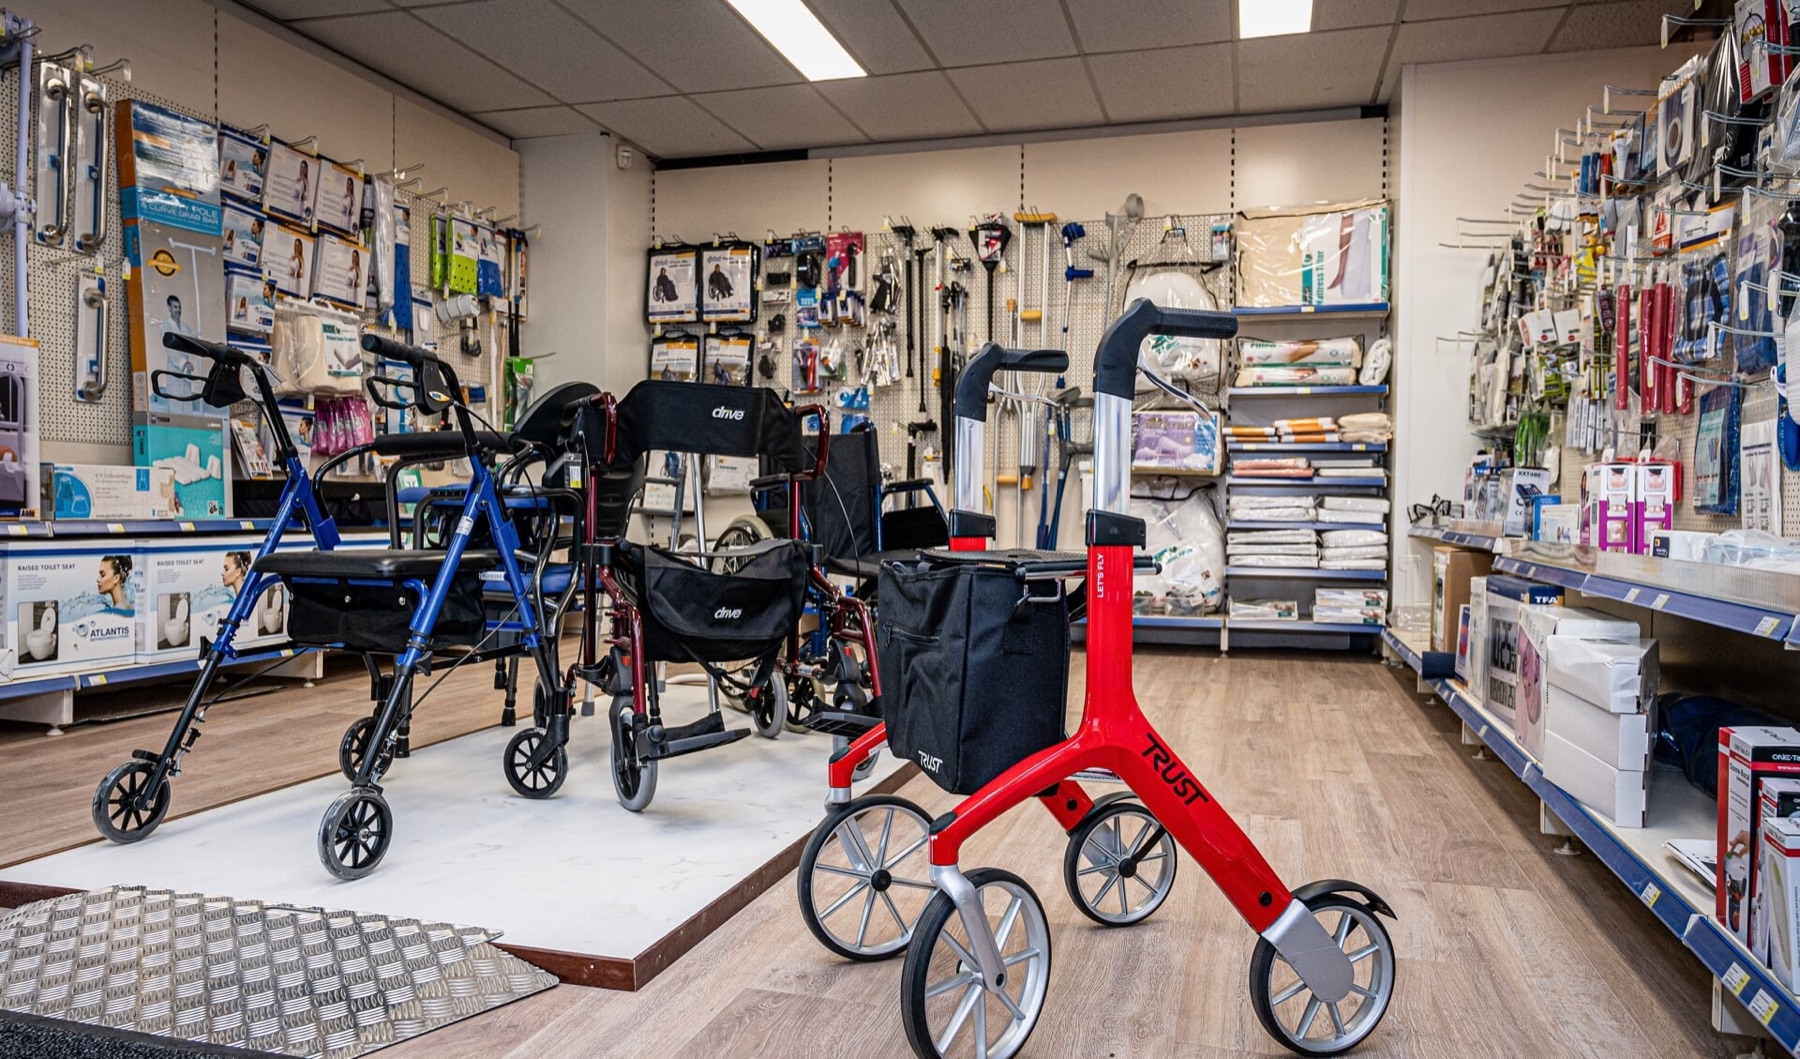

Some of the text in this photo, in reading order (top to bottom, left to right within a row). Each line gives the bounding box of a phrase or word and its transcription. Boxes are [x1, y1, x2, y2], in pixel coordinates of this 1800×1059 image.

[149, 204, 177, 216] CURVE
[178, 210, 201, 221] GRAB
[203, 216, 219, 225] BAR
[192, 205, 217, 217] POLE
[712, 406, 745, 420] drive
[1535, 595, 1558, 605] TFA
[714, 607, 742, 619] drive
[90, 626, 129, 638] ATLANTIS
[918, 750, 943, 774] TRUST
[1141, 733, 1210, 806] TRUST
